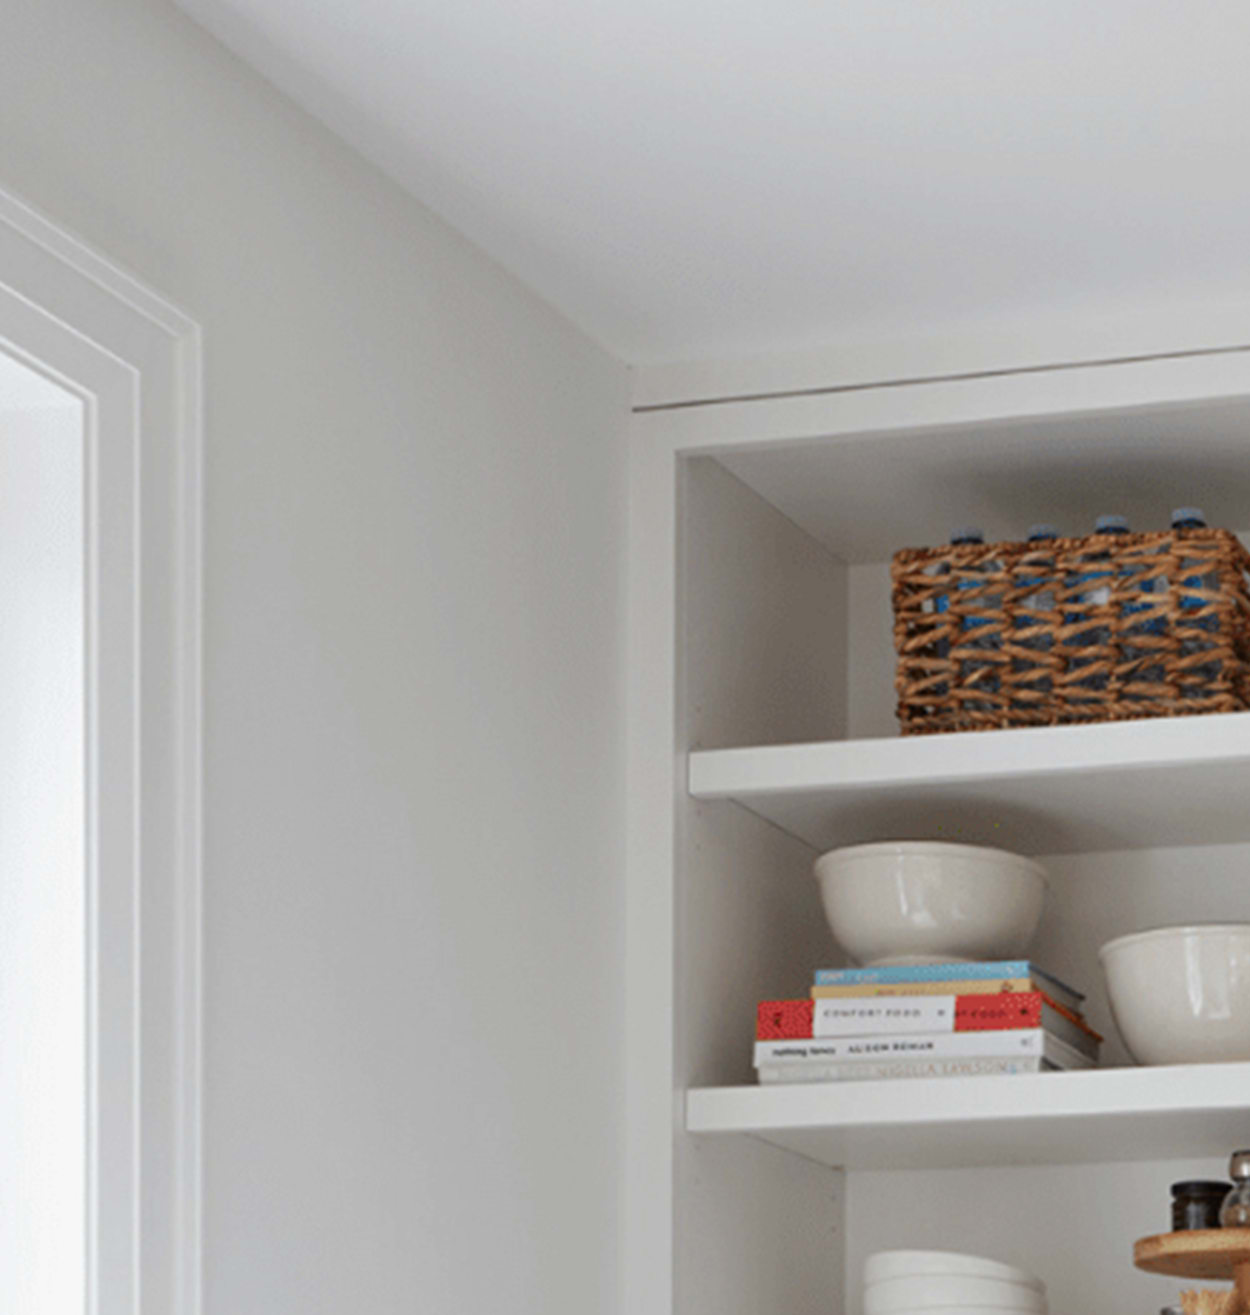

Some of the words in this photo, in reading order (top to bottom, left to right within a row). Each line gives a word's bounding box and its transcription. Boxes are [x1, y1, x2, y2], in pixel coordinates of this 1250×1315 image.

[823, 1009, 882, 1018] COMFORT
[885, 1008, 922, 1017] FOOD
[848, 1043, 889, 1053] ALISON
[893, 1041, 934, 1051] ROMAN
